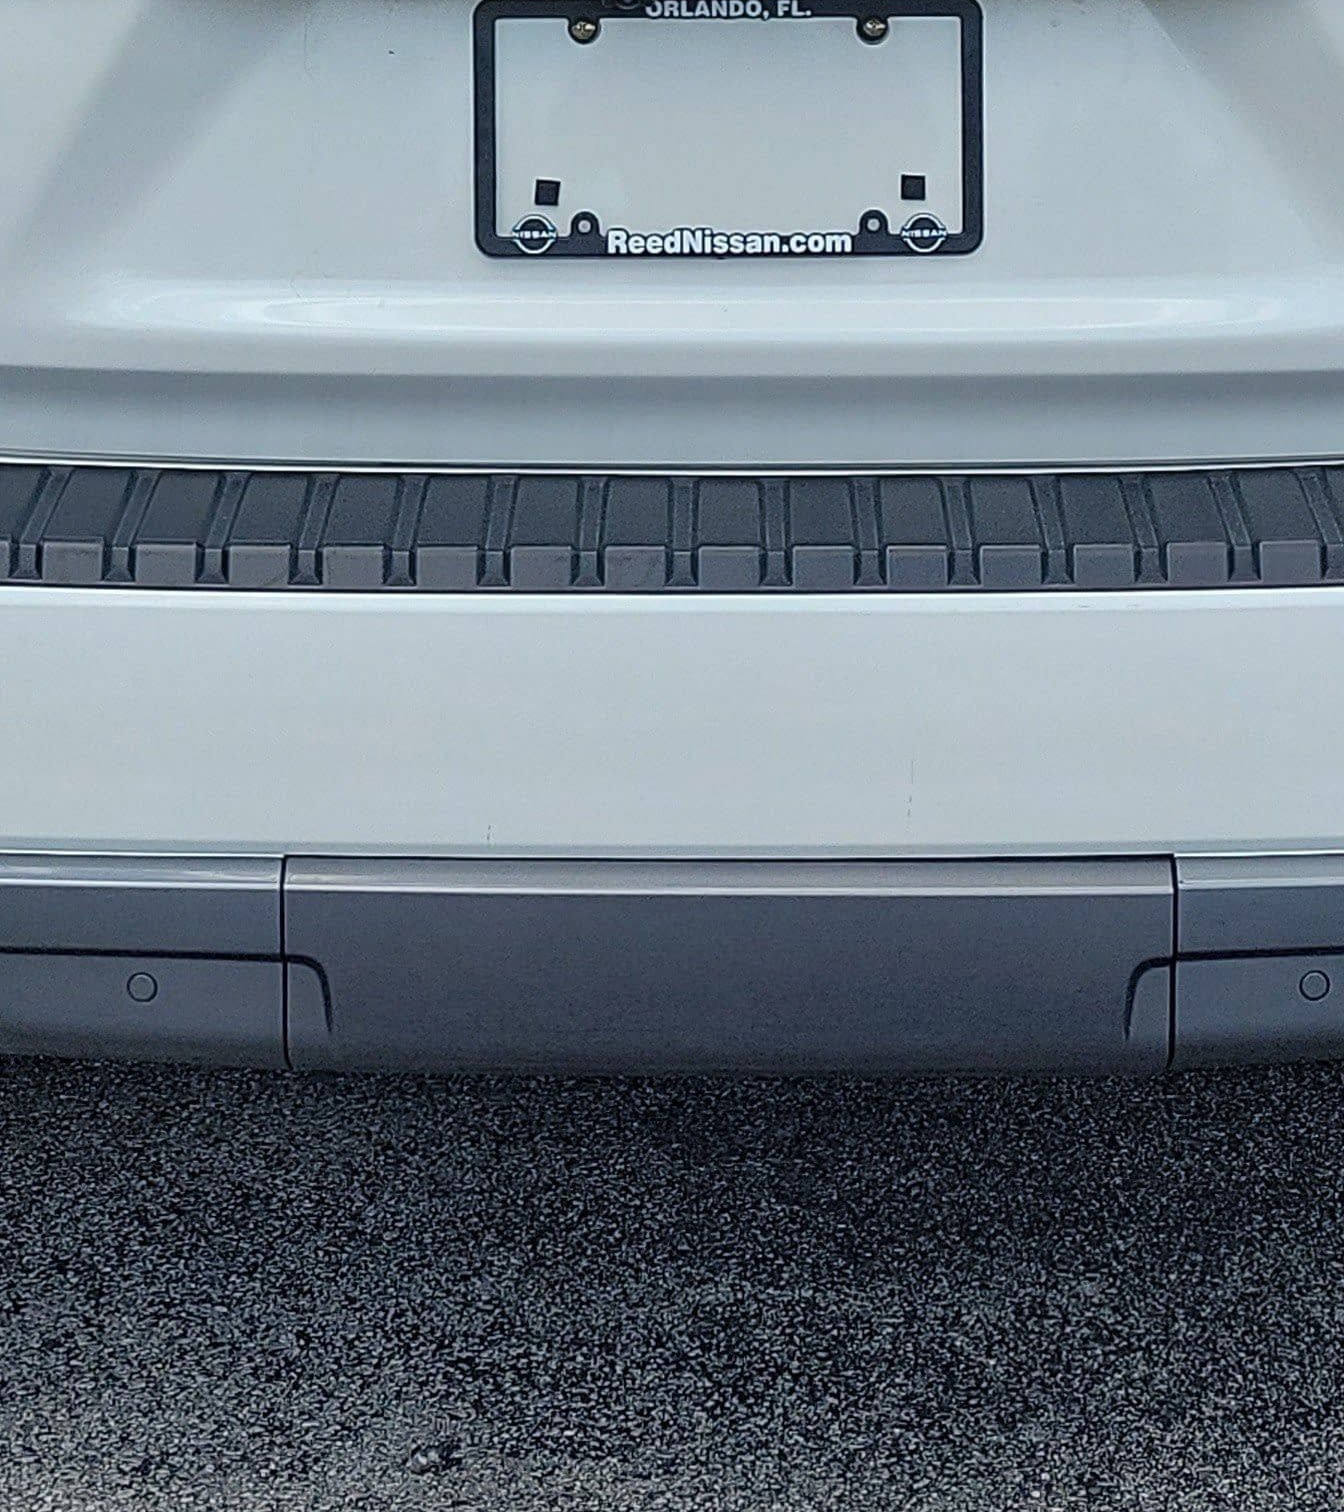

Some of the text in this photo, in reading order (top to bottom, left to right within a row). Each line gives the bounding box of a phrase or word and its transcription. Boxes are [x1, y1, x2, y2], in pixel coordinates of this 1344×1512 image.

[645, 0, 812, 20] ORLANDO, FL.
[512, 230, 557, 239] NISSAN
[607, 228, 853, 254] ReedNissan.com
[900, 229, 947, 239] NISSAN
